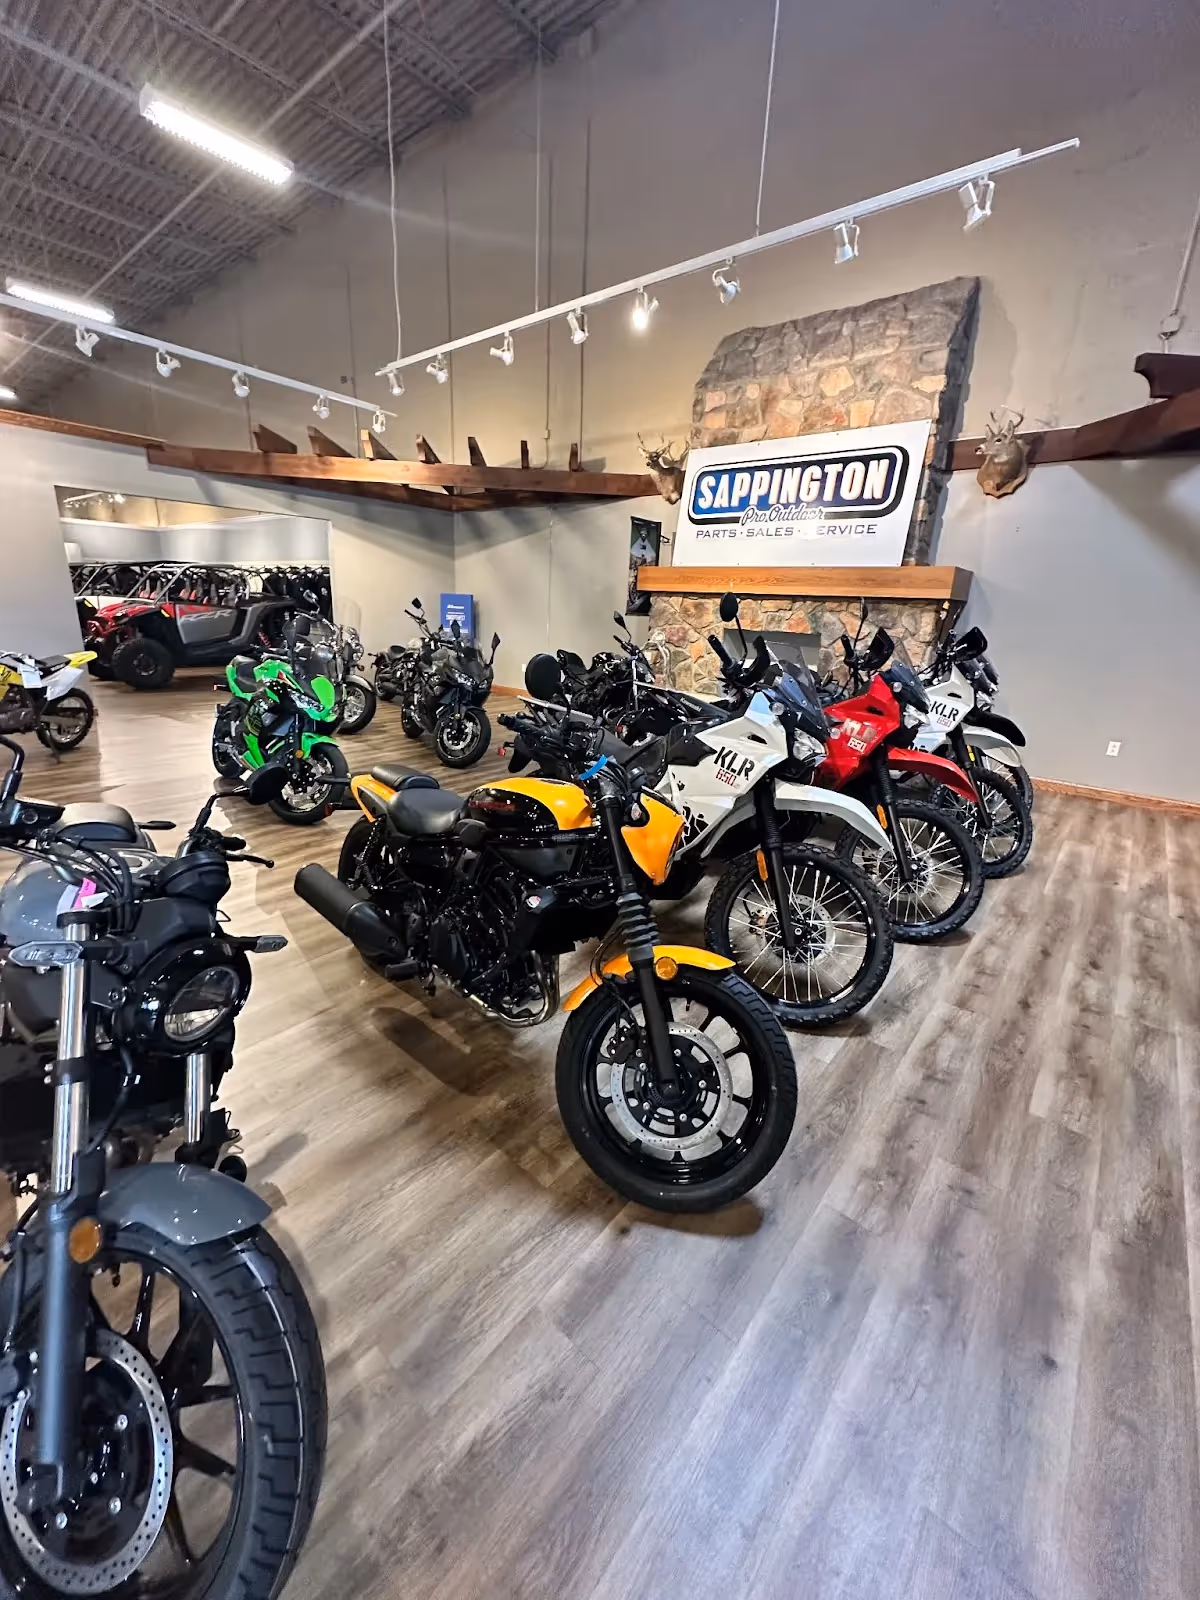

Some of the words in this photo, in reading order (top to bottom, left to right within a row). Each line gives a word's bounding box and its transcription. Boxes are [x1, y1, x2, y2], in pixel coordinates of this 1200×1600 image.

[698, 459, 890, 510] SAPPINGTON
[695, 529, 737, 539] PARTS
[745, 526, 794, 537] SALES
[806, 523, 878, 538] ERVICE
[930, 700, 960, 722] KLR
[936, 717, 953, 728] 650
[847, 736, 868, 753] 650
[713, 745, 756, 781] KLR
[715, 768, 738, 787] 650
